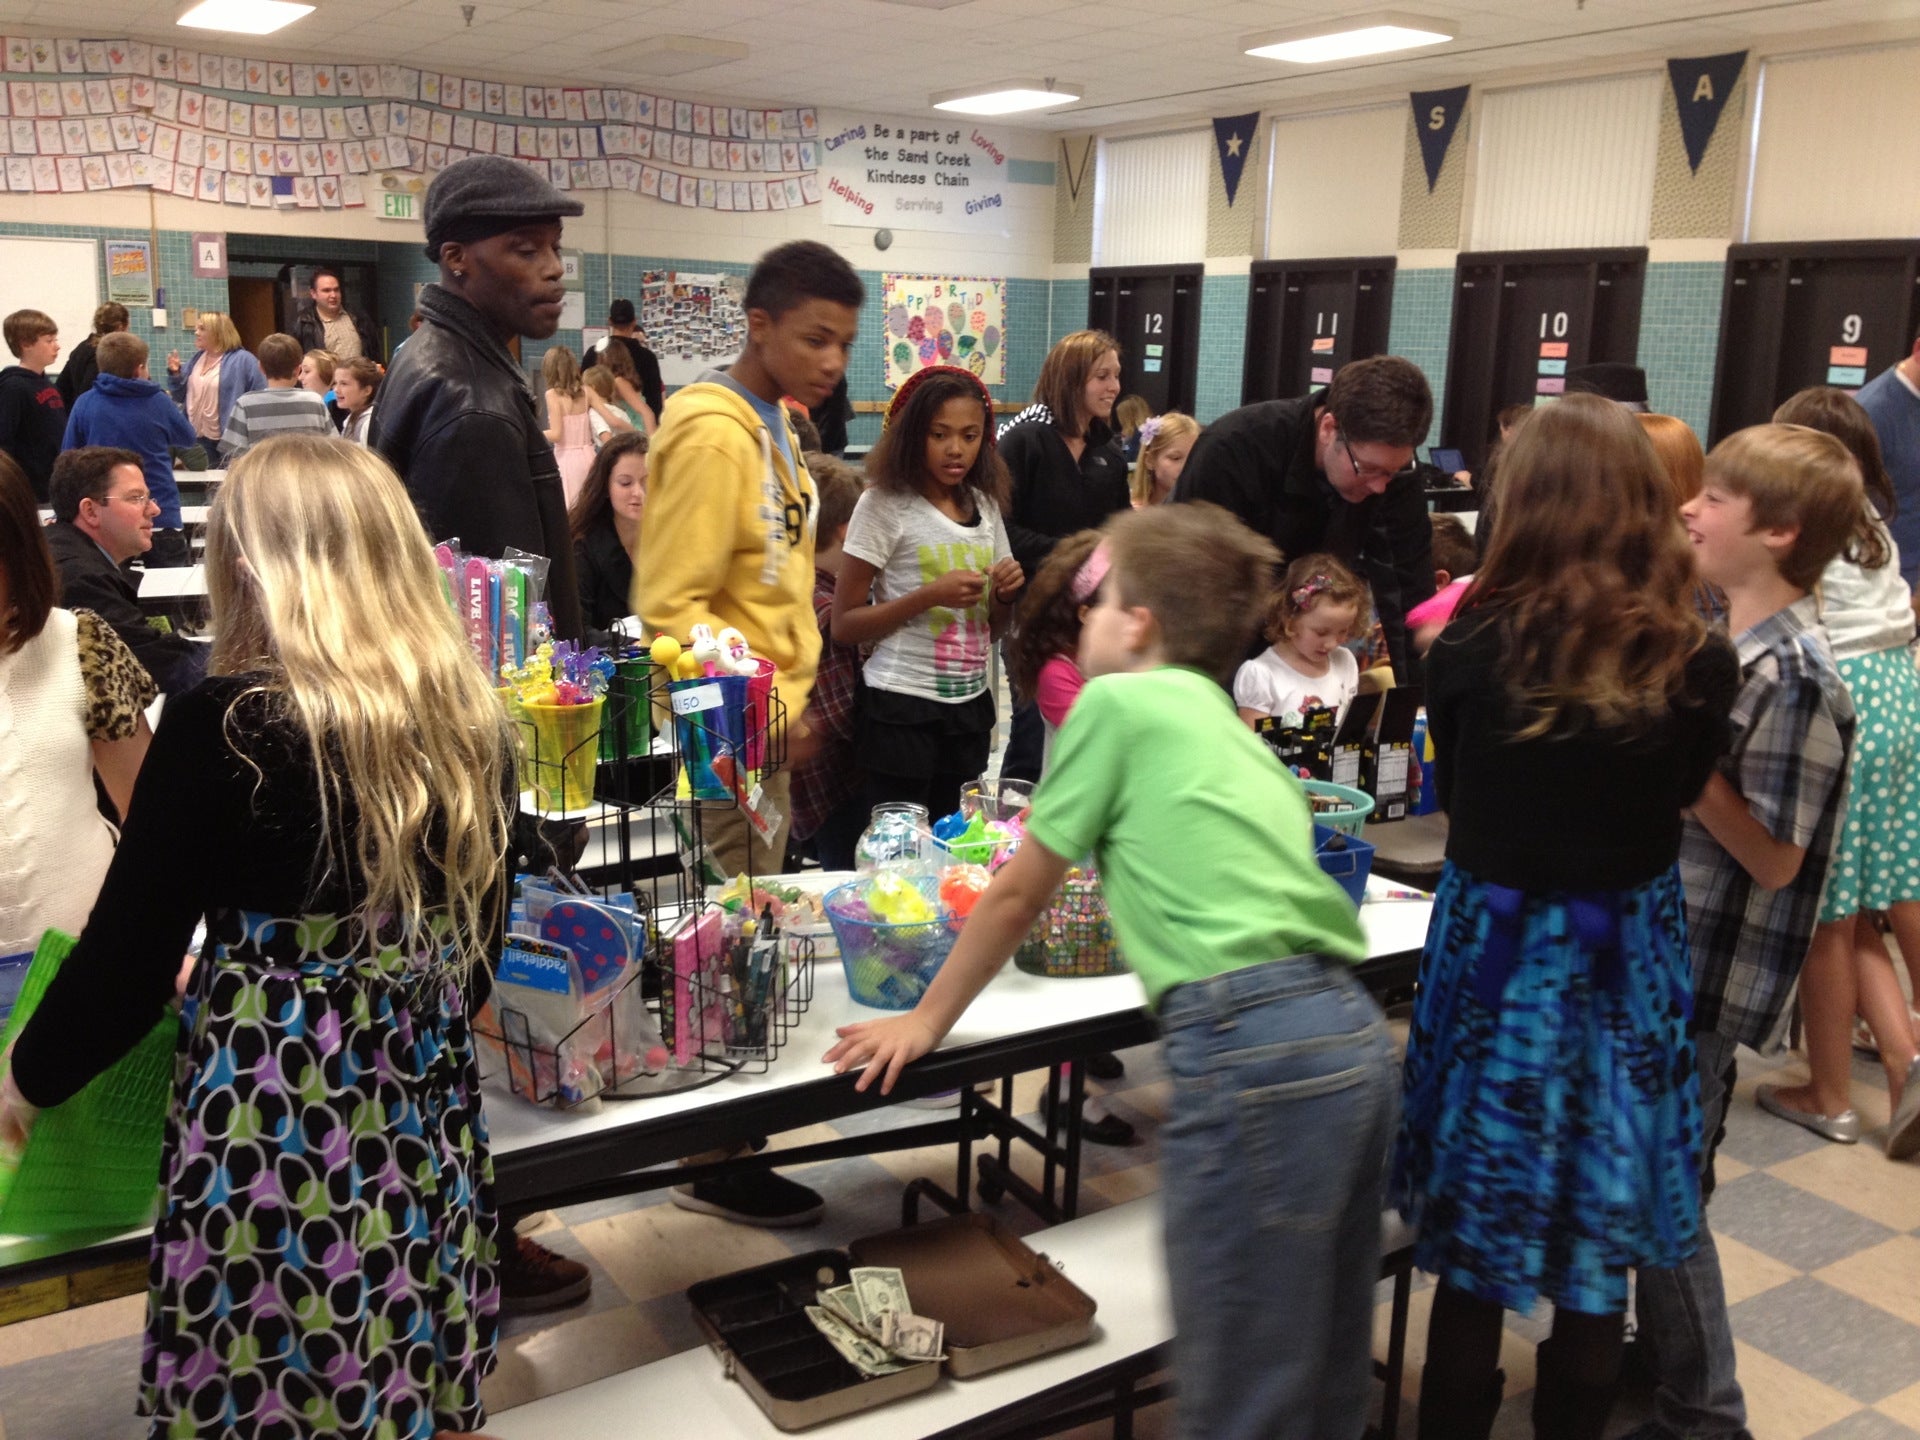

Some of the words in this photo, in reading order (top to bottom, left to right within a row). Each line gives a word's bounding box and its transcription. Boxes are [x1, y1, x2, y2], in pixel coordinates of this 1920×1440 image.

[1692, 74, 1714, 102] A
[1428, 106, 1446, 130] S
[824, 124, 867, 151] Caring
[873, 124, 889, 138] Be
[896, 130, 904, 139] a
[910, 129, 939, 144] part
[946, 131, 960, 145] of
[864, 147, 888, 161] the
[897, 149, 928, 164] Sand
[935, 152, 971, 167] Creek
[970, 129, 1005, 166] Loving
[866, 169, 926, 184] Kindness
[935, 173, 969, 187] Chain
[384, 193, 413, 217] EXIT
[828, 176, 874, 215] Helping
[895, 198, 943, 214] Serving
[965, 193, 1003, 215] Giving
[204, 249, 214, 261] A
[565, 263, 574, 273] B
[1145, 313, 1163, 334] 12
[1316, 312, 1339, 335] 11
[1539, 311, 1569, 339] 10
[1842, 314, 1862, 344] 9
[470, 578, 482, 619] LIVE
[507, 951, 567, 974] Paddleball
